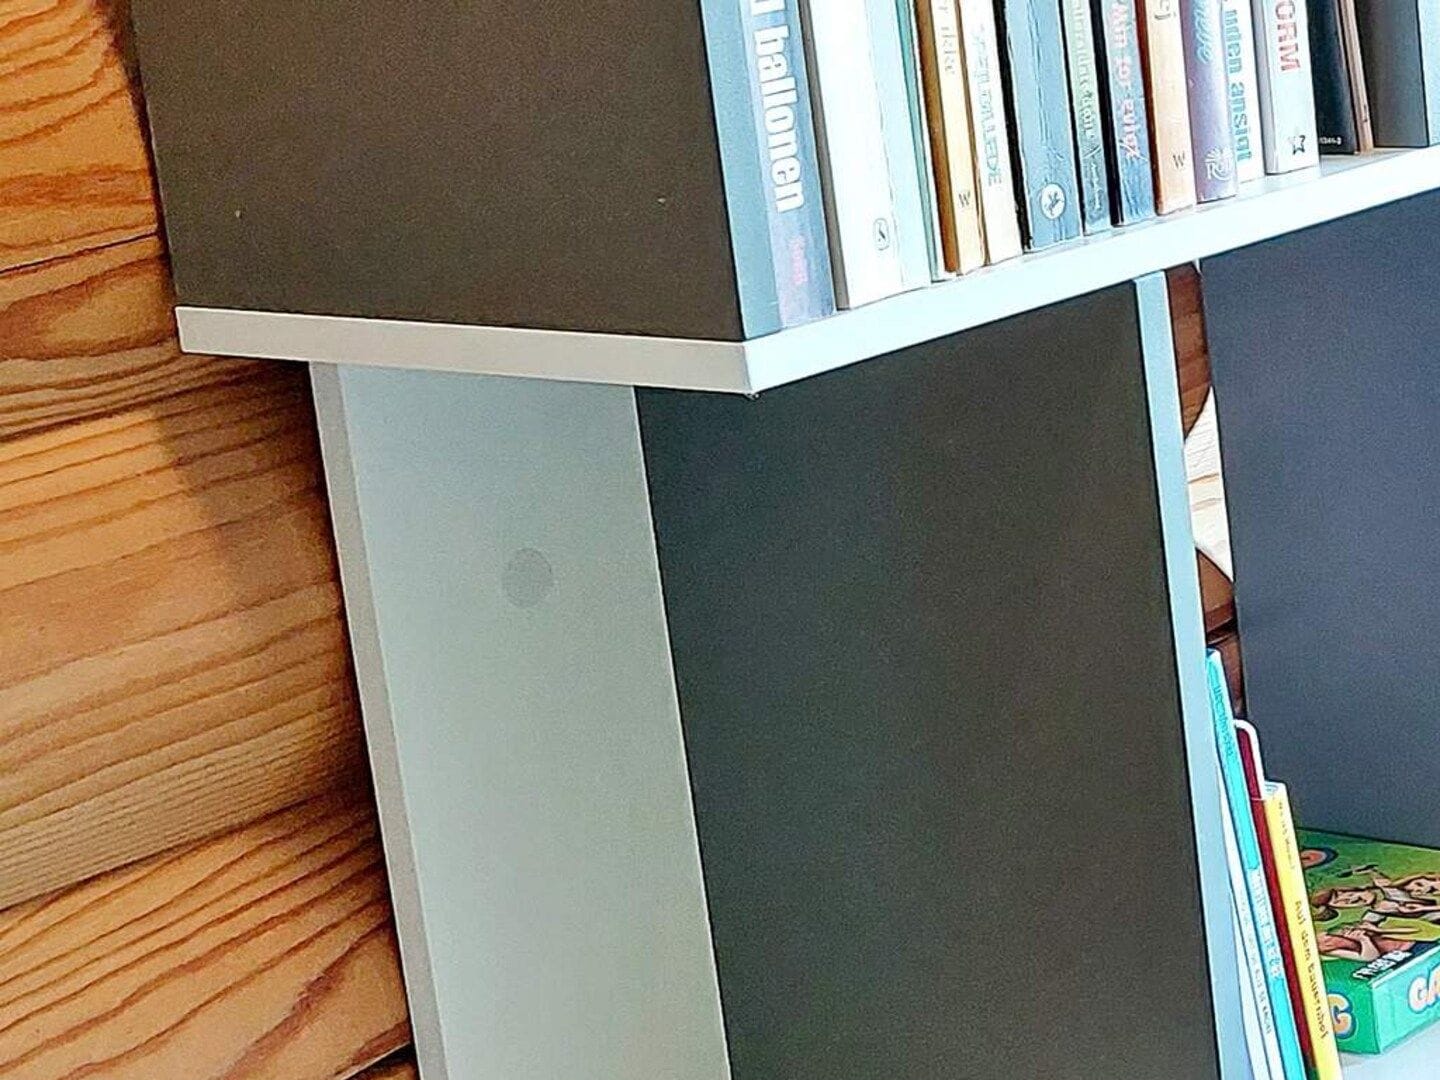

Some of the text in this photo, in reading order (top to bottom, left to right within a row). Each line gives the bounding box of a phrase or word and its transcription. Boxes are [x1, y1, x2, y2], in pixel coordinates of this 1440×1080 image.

[754, 24, 804, 213] ballonen
[1223, 9, 1252, 163] uden ansigt
[1302, 930, 1316, 960] dem
